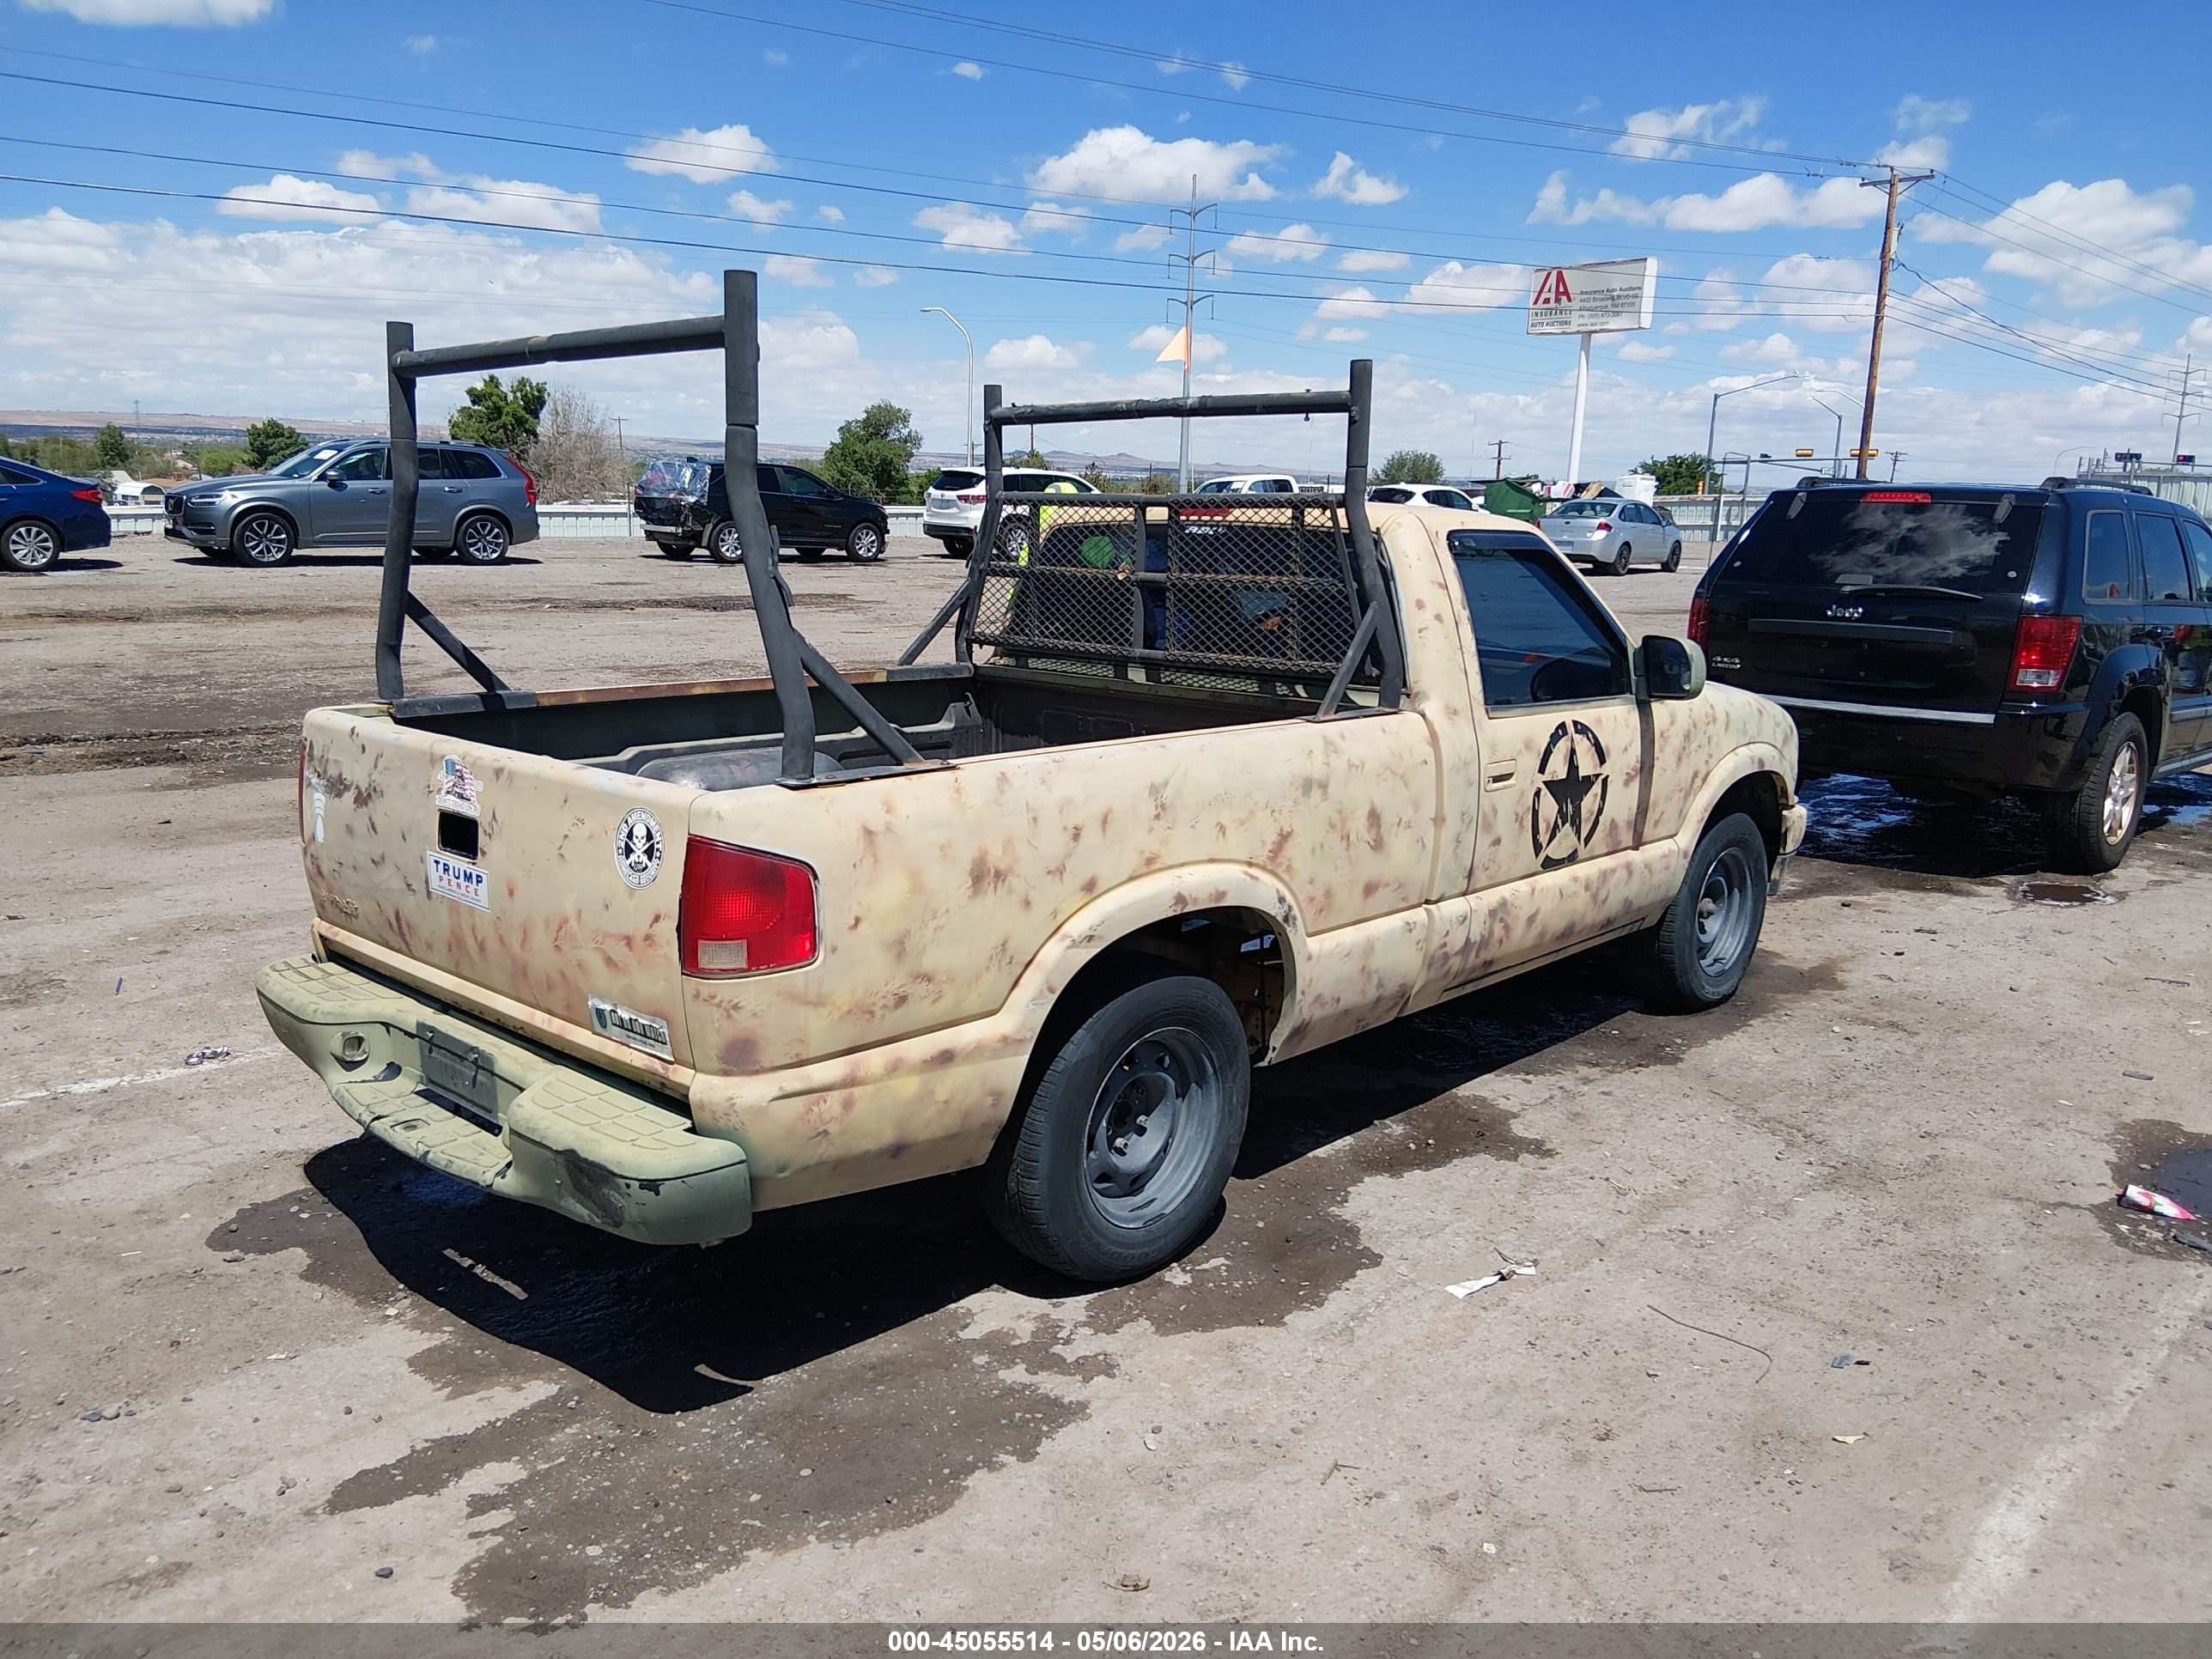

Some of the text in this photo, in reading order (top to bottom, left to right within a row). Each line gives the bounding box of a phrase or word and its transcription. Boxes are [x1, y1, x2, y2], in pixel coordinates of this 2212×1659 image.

[1531, 309, 1572, 318] INSURANCE
[1546, 319, 1571, 327] AUCTIONS
[1826, 604, 1863, 620] Jeep
[627, 811, 663, 852] AMENDMENT
[434, 860, 483, 887] TRUMP
[439, 875, 480, 896] PENCE
